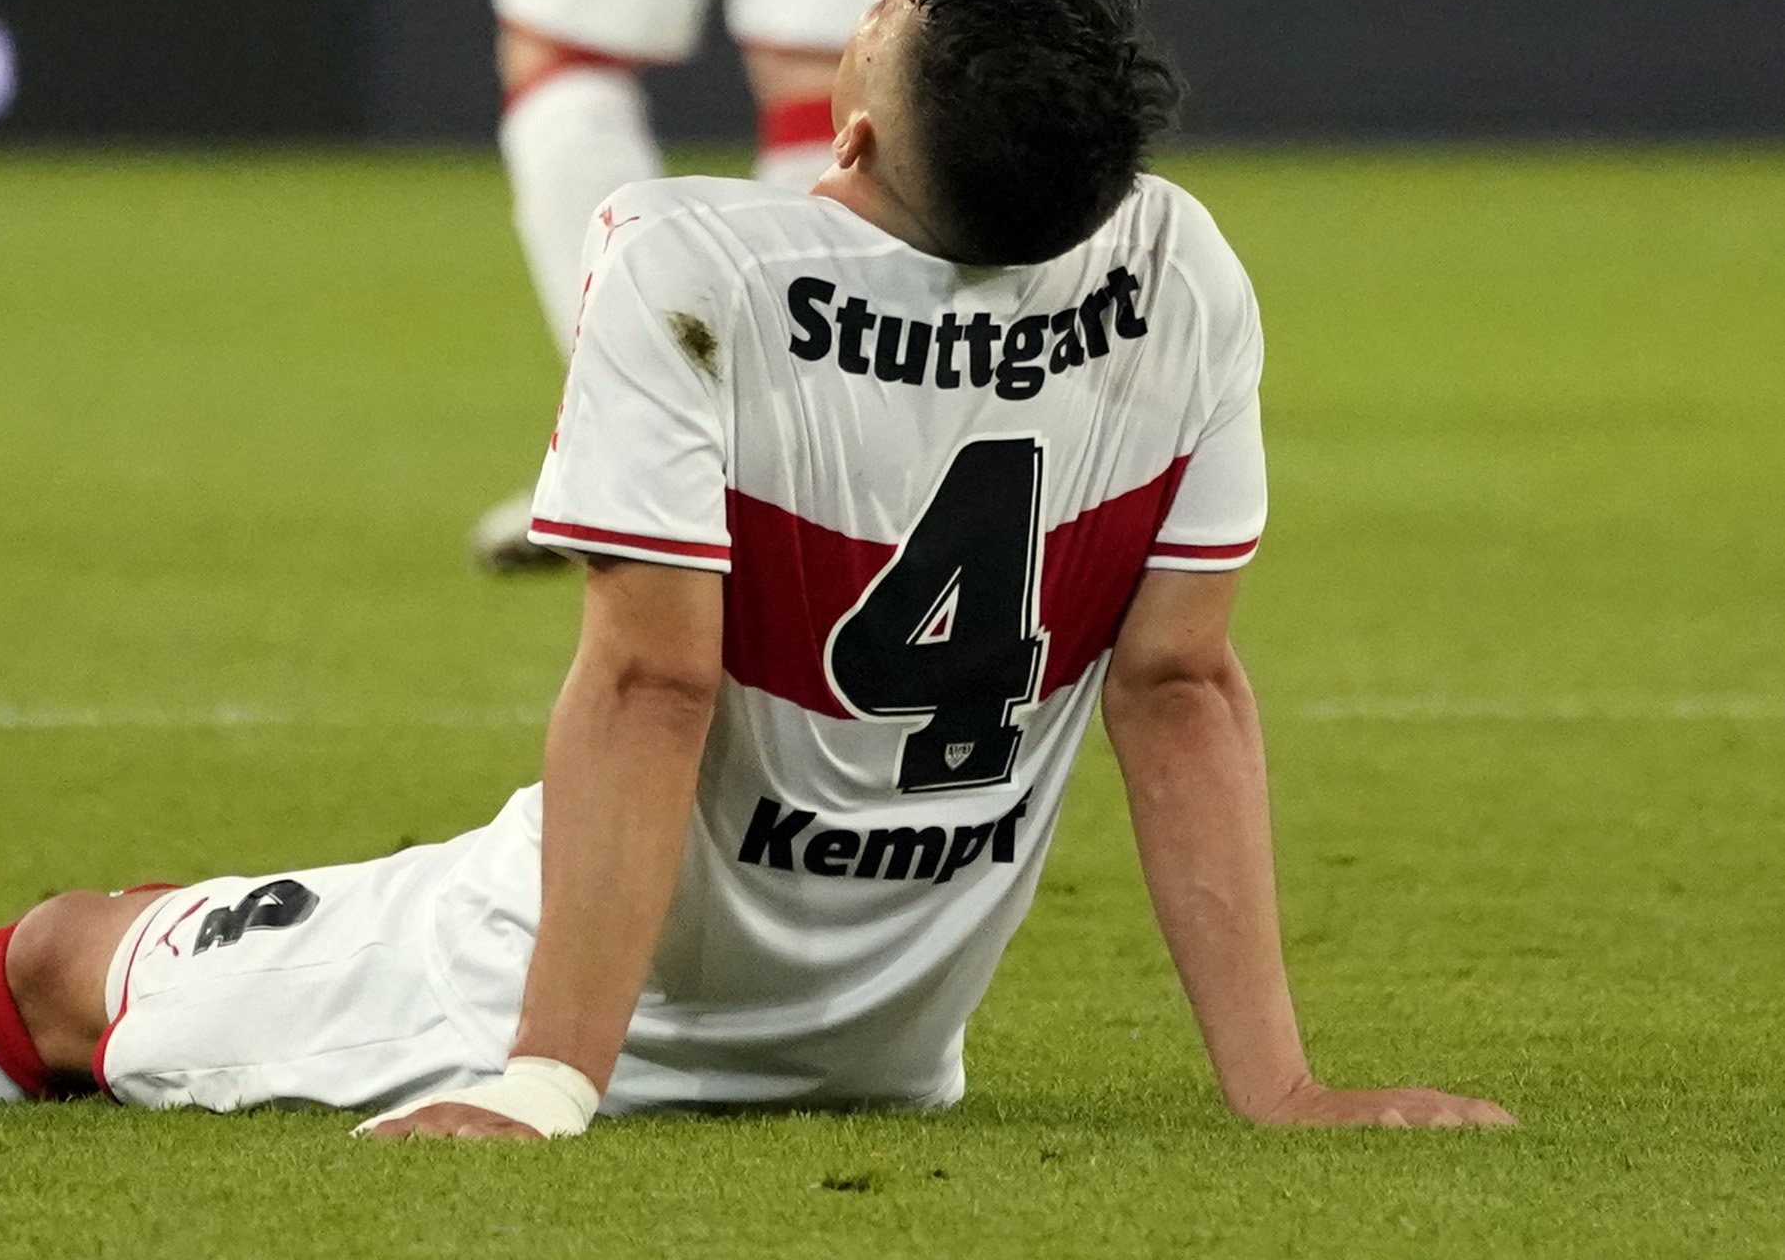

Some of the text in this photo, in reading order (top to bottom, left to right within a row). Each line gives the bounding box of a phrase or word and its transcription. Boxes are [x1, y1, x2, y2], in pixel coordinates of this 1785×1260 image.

[787, 266, 1148, 401] Stuttgart
[828, 434, 1047, 794] 4
[738, 786, 1034, 885] Kempf
